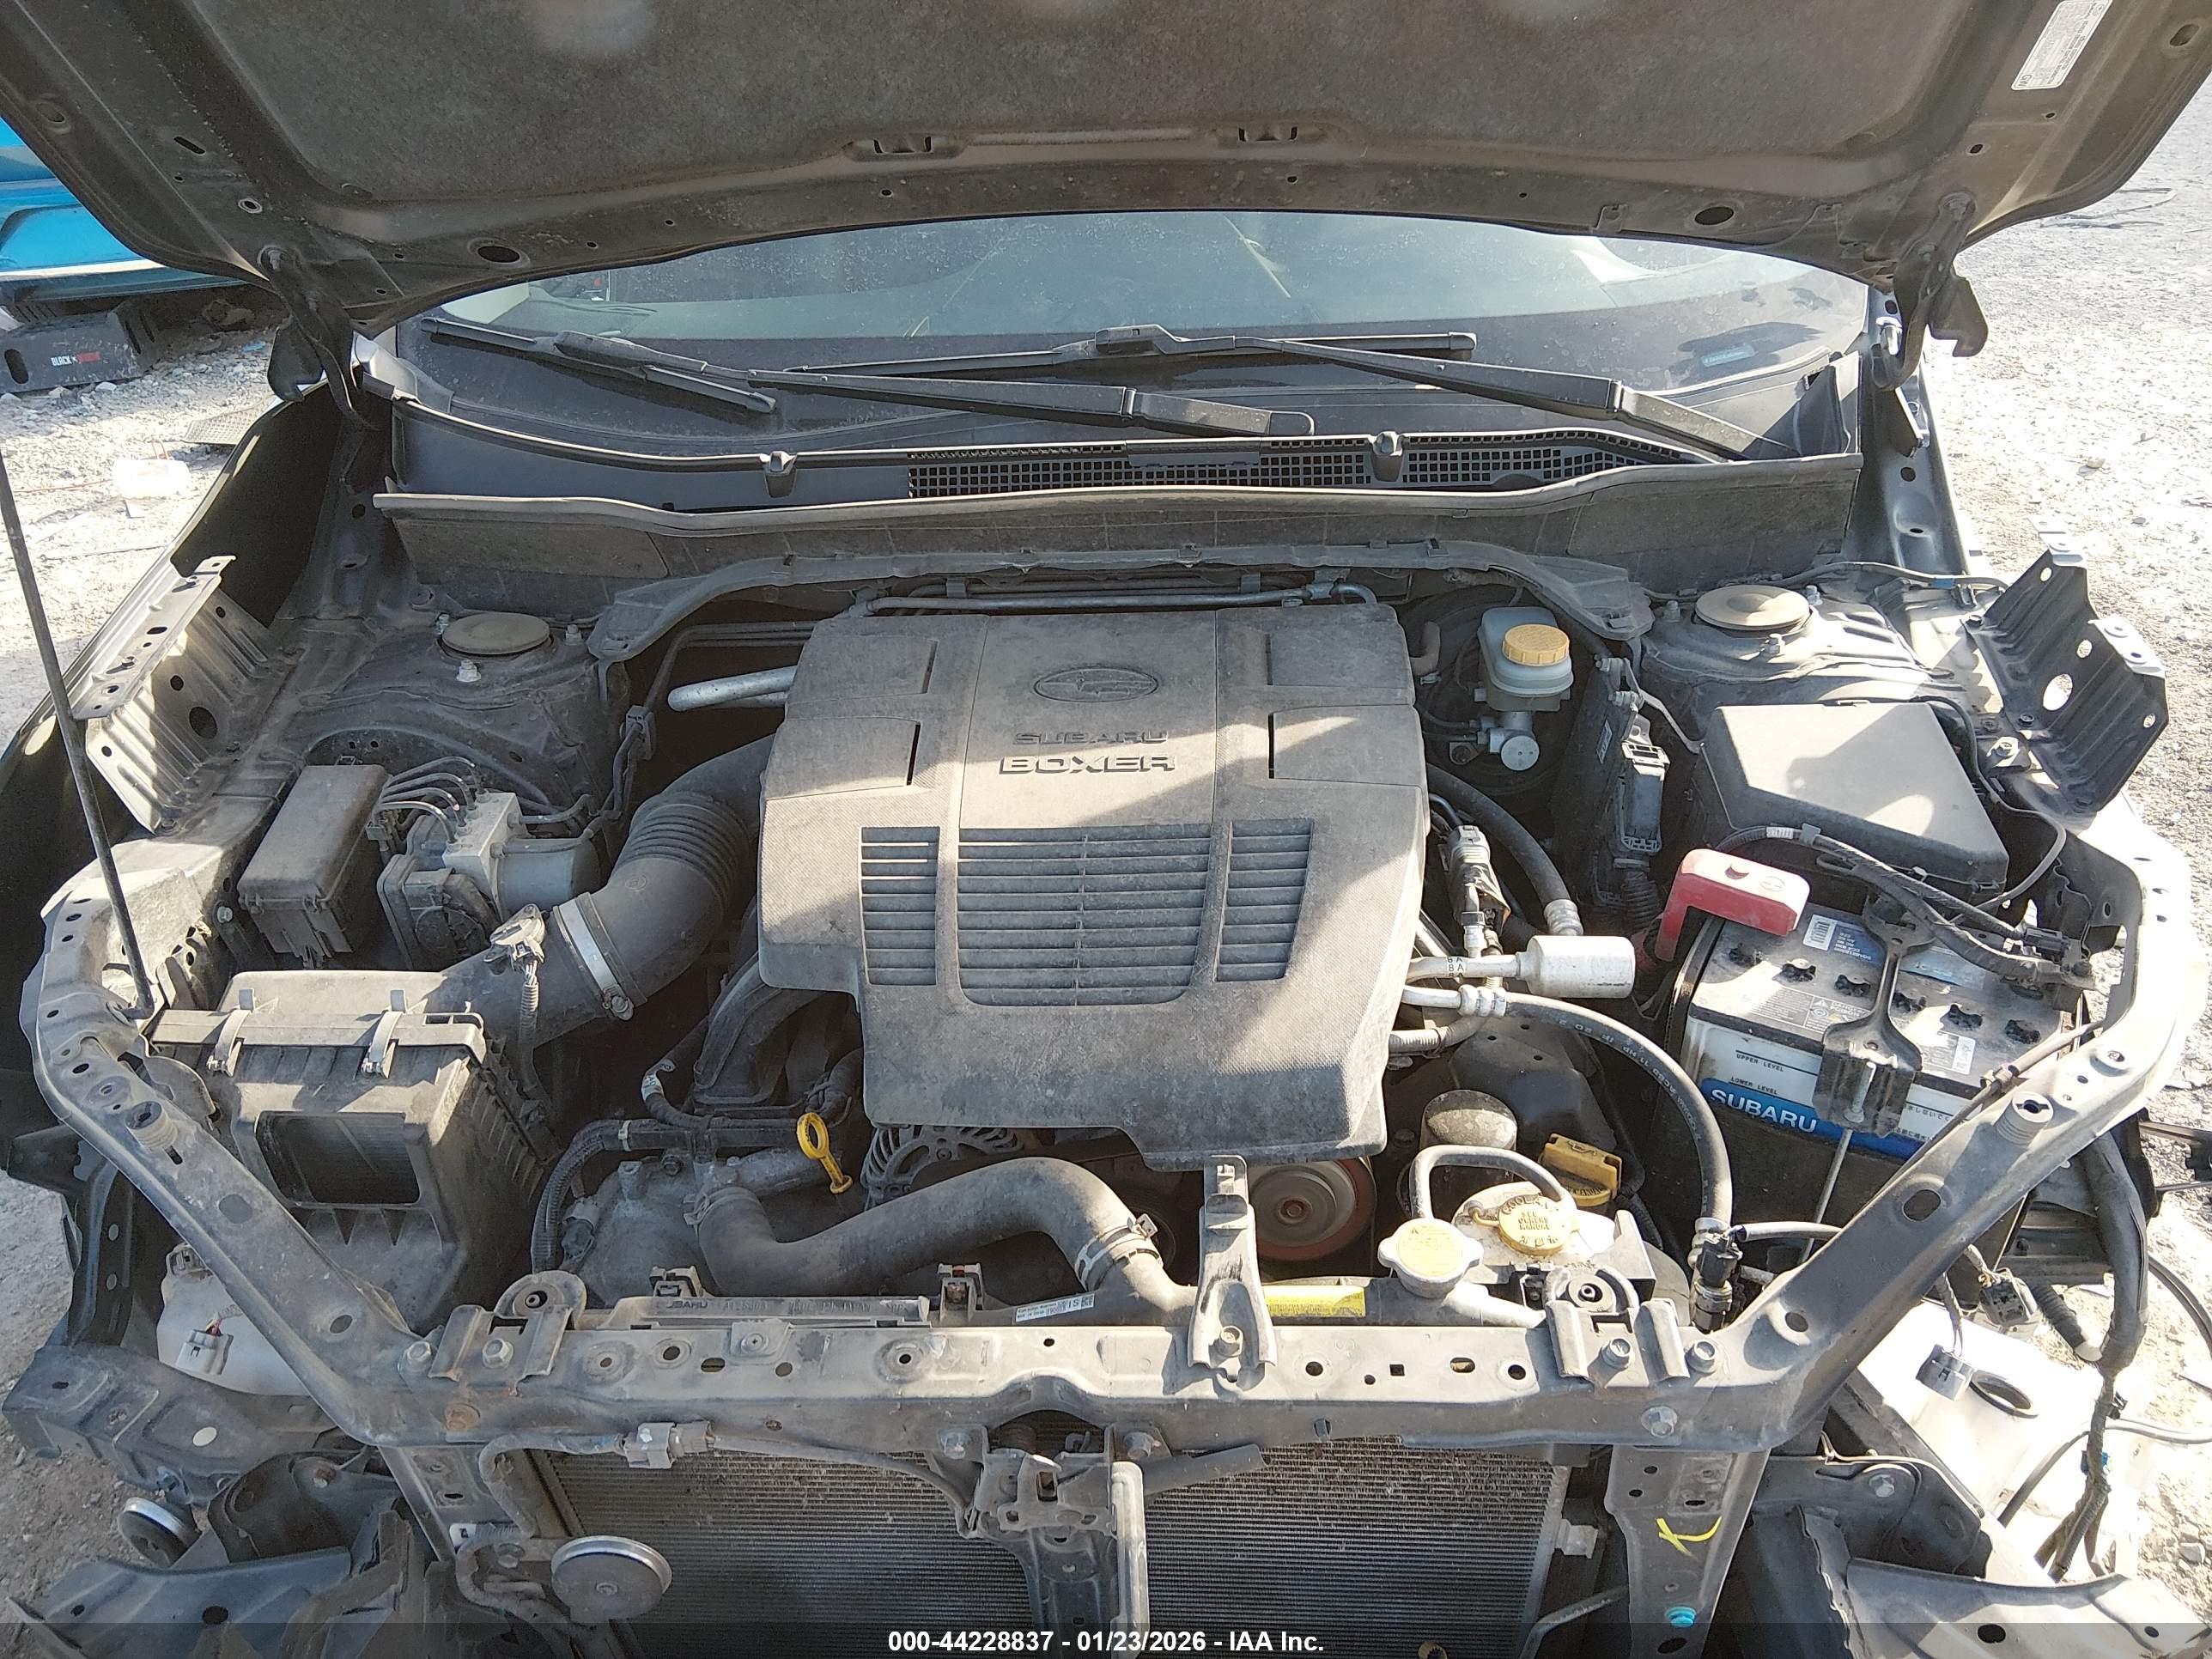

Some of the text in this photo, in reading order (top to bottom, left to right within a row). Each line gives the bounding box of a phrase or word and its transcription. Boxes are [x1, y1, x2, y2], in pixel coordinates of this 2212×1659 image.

[51, 356, 72, 367] BLACK
[1012, 731, 1169, 745] SUBARU
[999, 756, 1176, 775] BOXER
[1735, 1054, 1784, 1073] UPPER LEVEL
[1730, 1076, 1778, 1096] LOWER LEVEL
[1711, 1089, 1818, 1133] SUBARU
